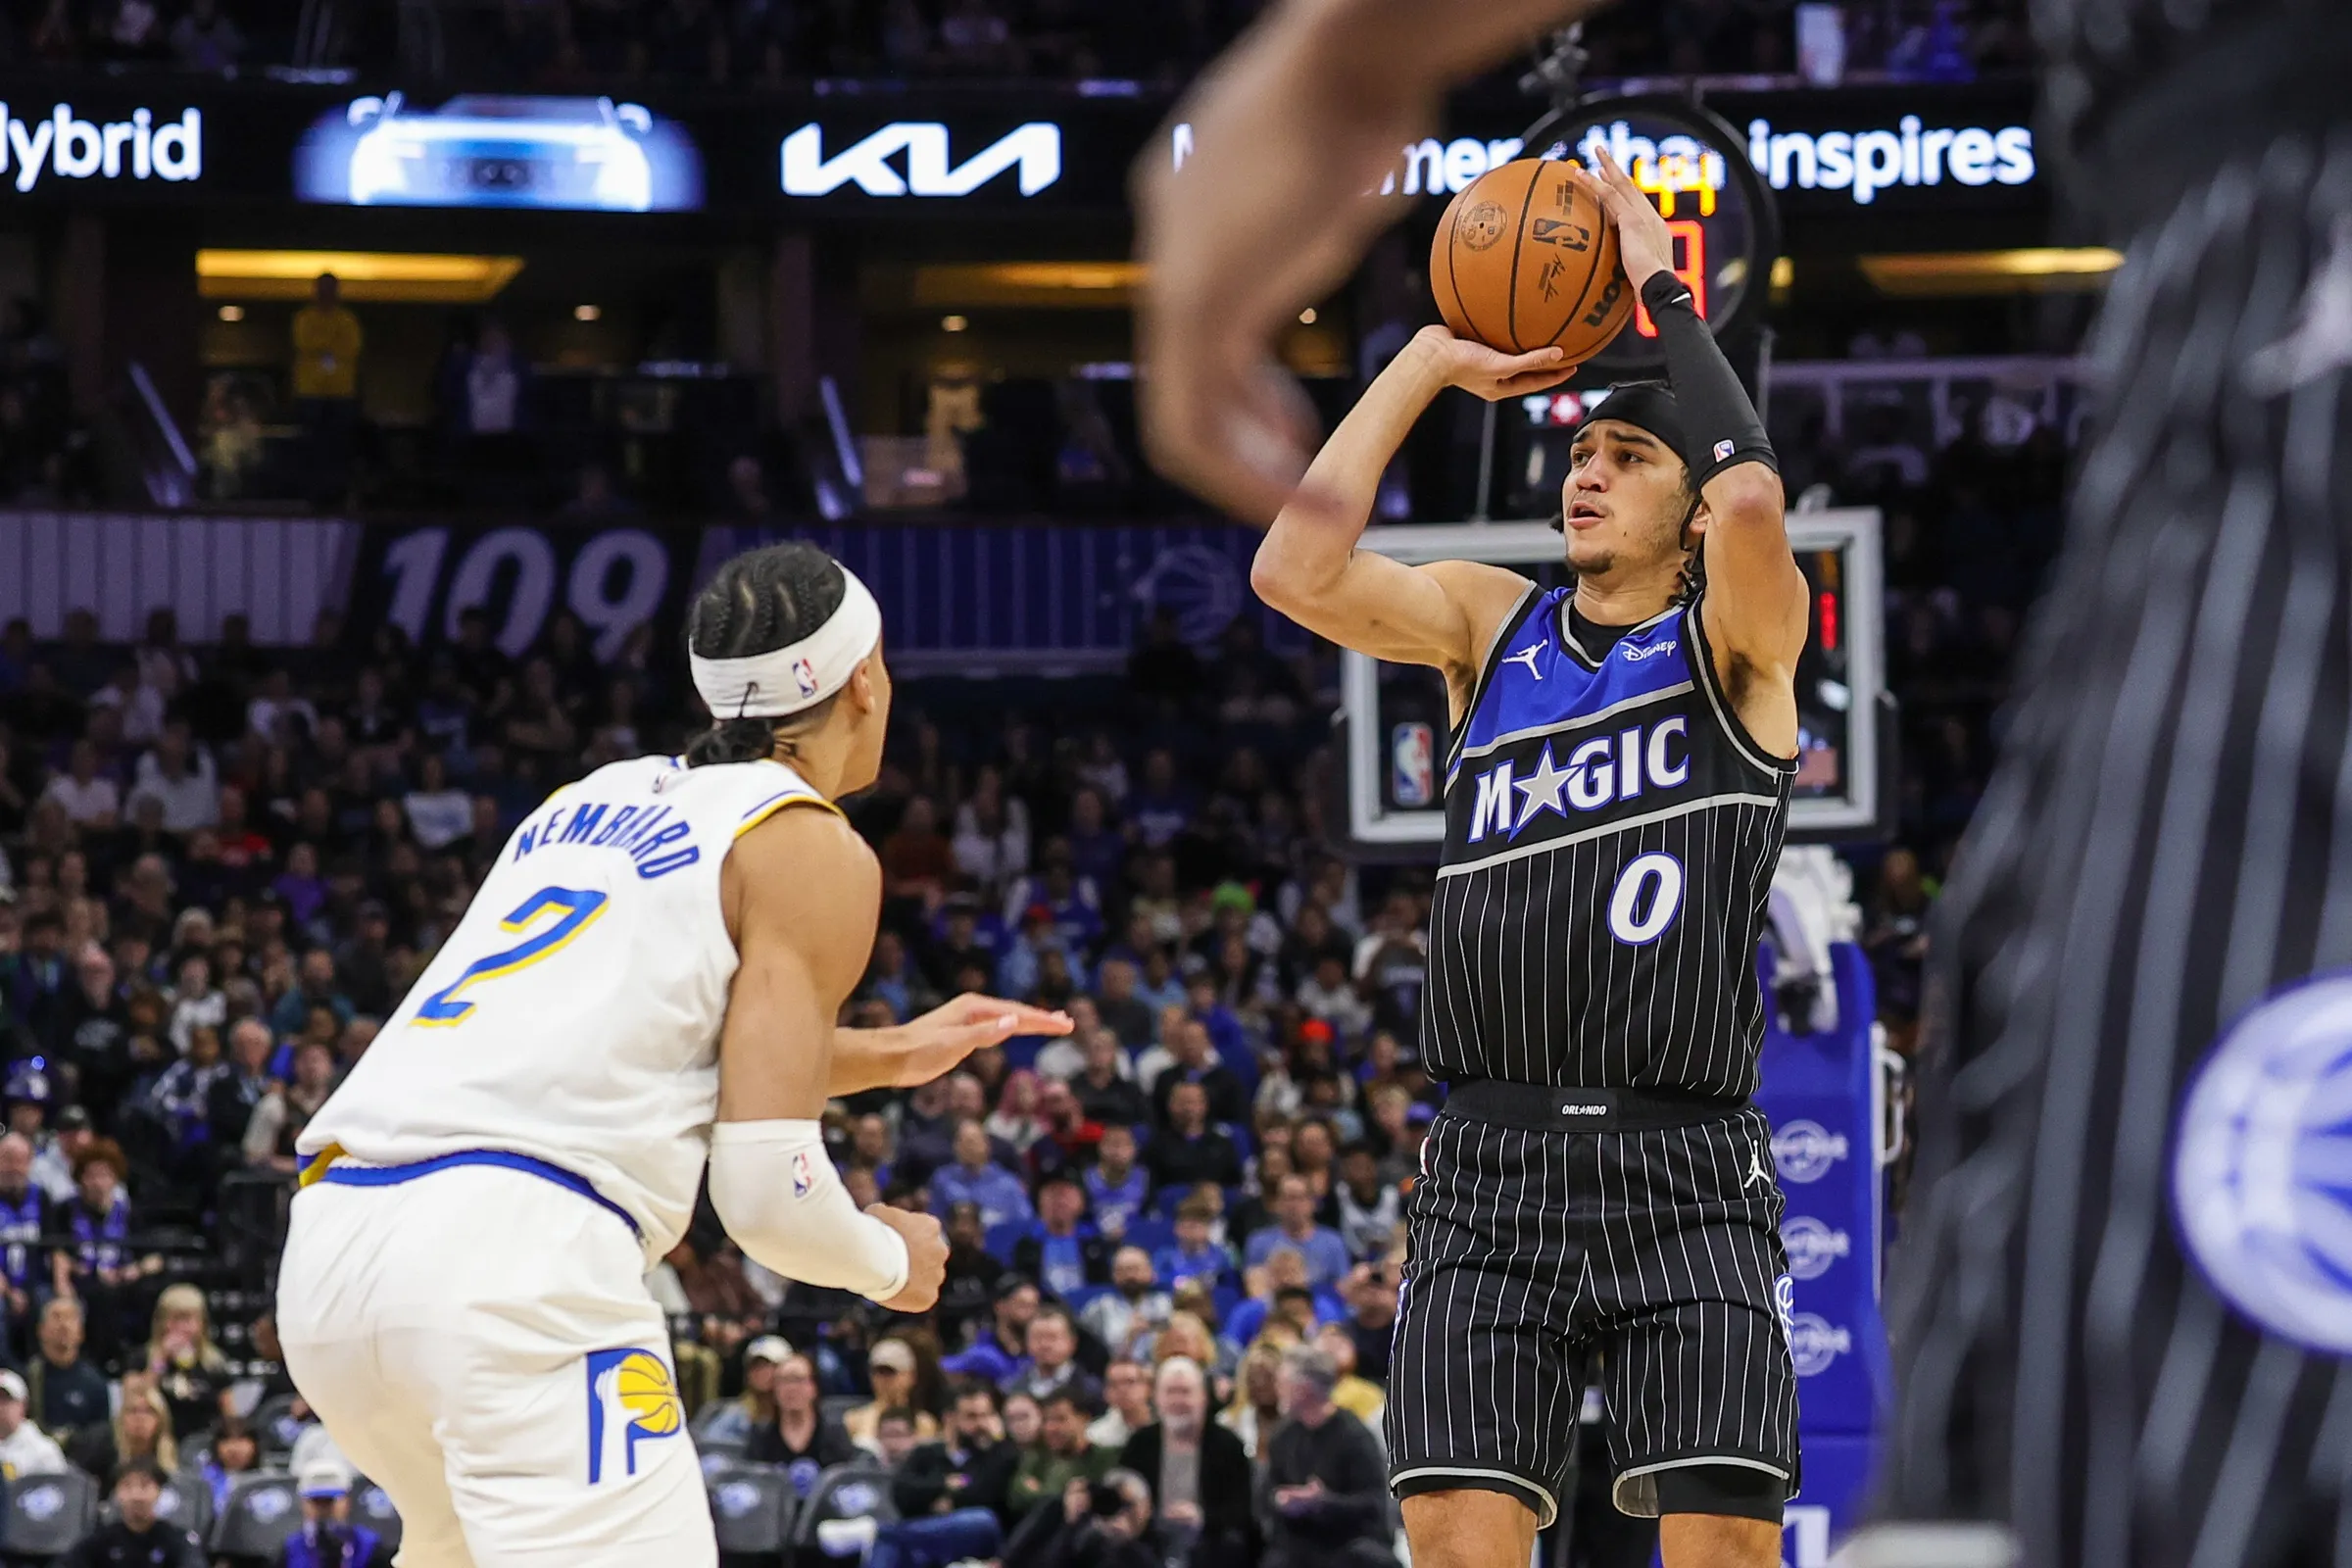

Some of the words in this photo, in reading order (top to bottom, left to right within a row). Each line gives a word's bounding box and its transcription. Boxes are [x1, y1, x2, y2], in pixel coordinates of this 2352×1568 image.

[1747, 115, 2035, 204] inspires
[383, 527, 668, 662] 109
[1606, 851, 1685, 946] 0
[408, 885, 610, 1029] 2
